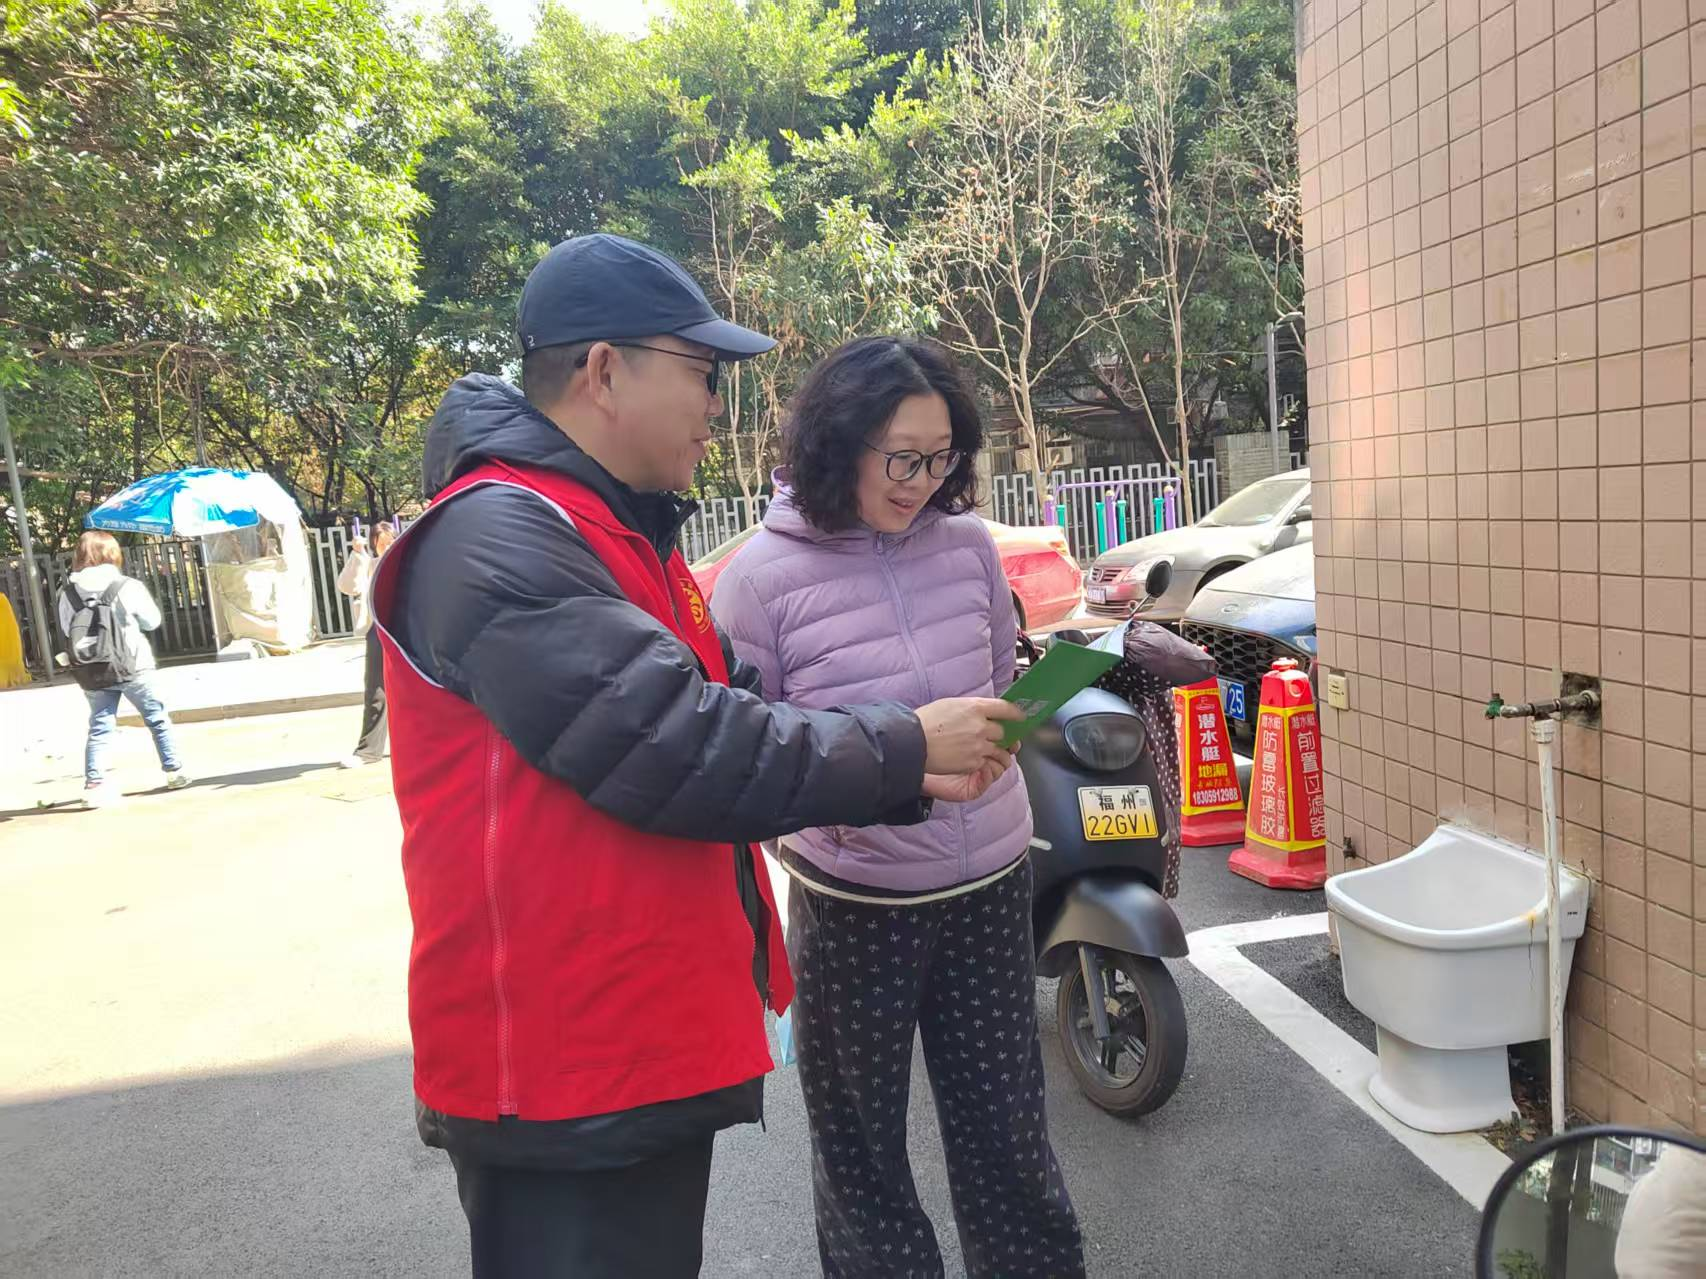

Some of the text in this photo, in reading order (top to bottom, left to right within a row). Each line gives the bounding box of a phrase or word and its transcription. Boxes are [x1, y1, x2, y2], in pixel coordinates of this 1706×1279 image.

[1198, 713, 1220, 762] 潜水艇
[1198, 762, 1228, 778] 地漏
[1262, 729, 1278, 838] 防霉玻璃胶
[1297, 730, 1326, 838] 前置过滤器
[1098, 793, 1137, 811] 福州
[1088, 813, 1150, 836] 22GV1
